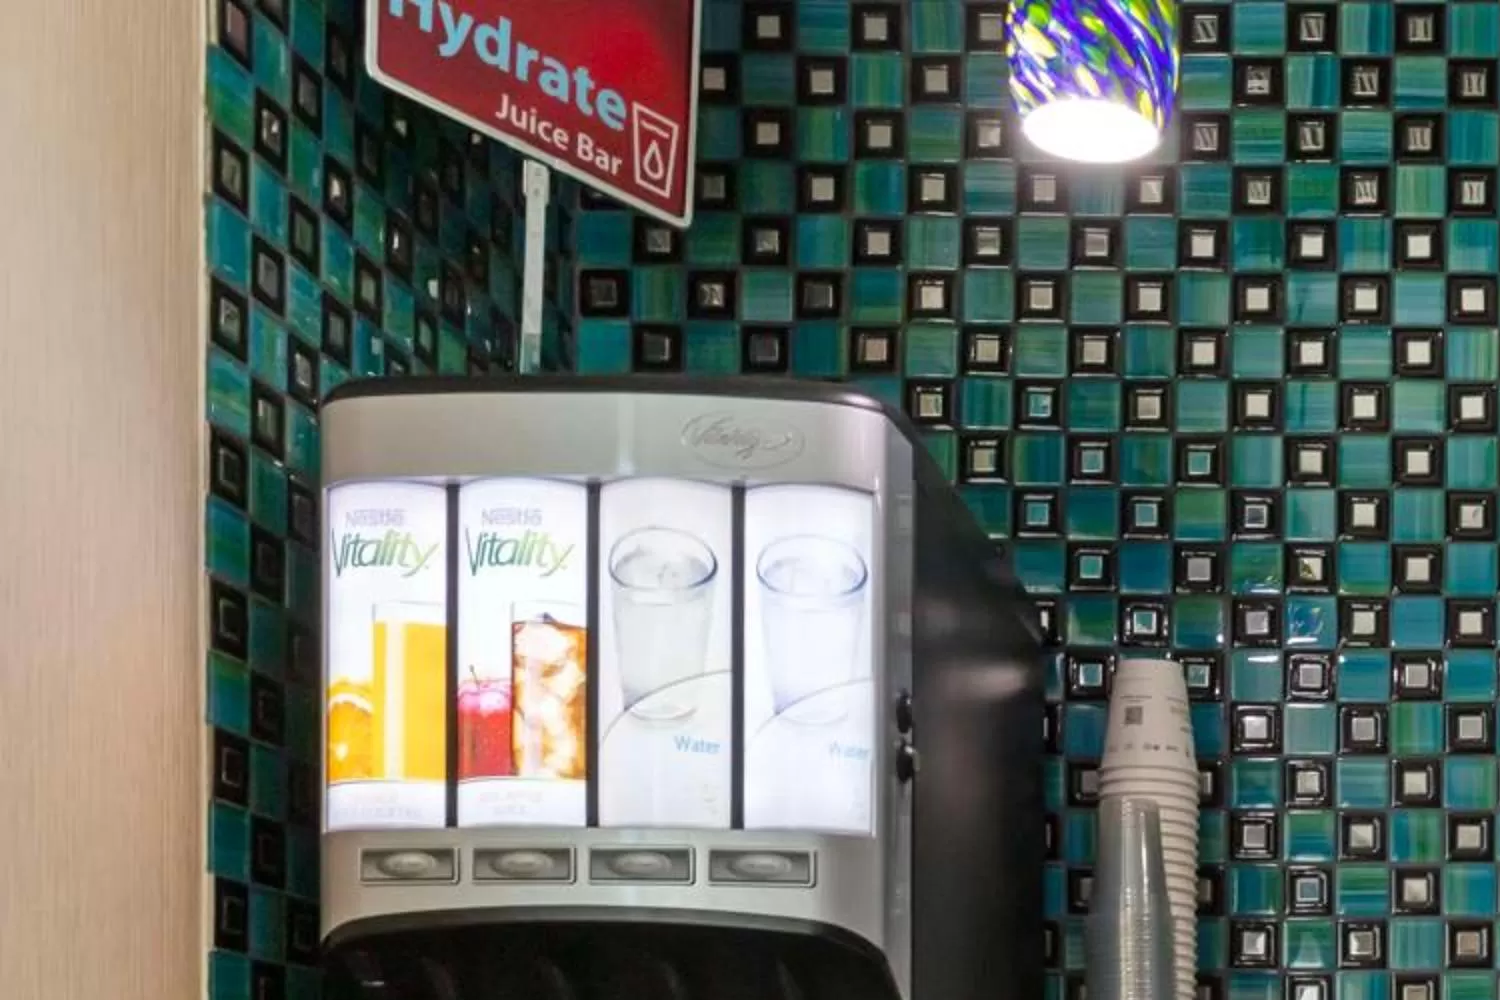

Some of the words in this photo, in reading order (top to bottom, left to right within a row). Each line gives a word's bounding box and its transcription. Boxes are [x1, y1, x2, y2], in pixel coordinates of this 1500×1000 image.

[495, 94, 569, 149] Juice
[577, 132, 623, 175] Bar
[331, 527, 440, 578] Vitality
[466, 527, 575, 578] Vitality
[673, 734, 720, 754] Water
